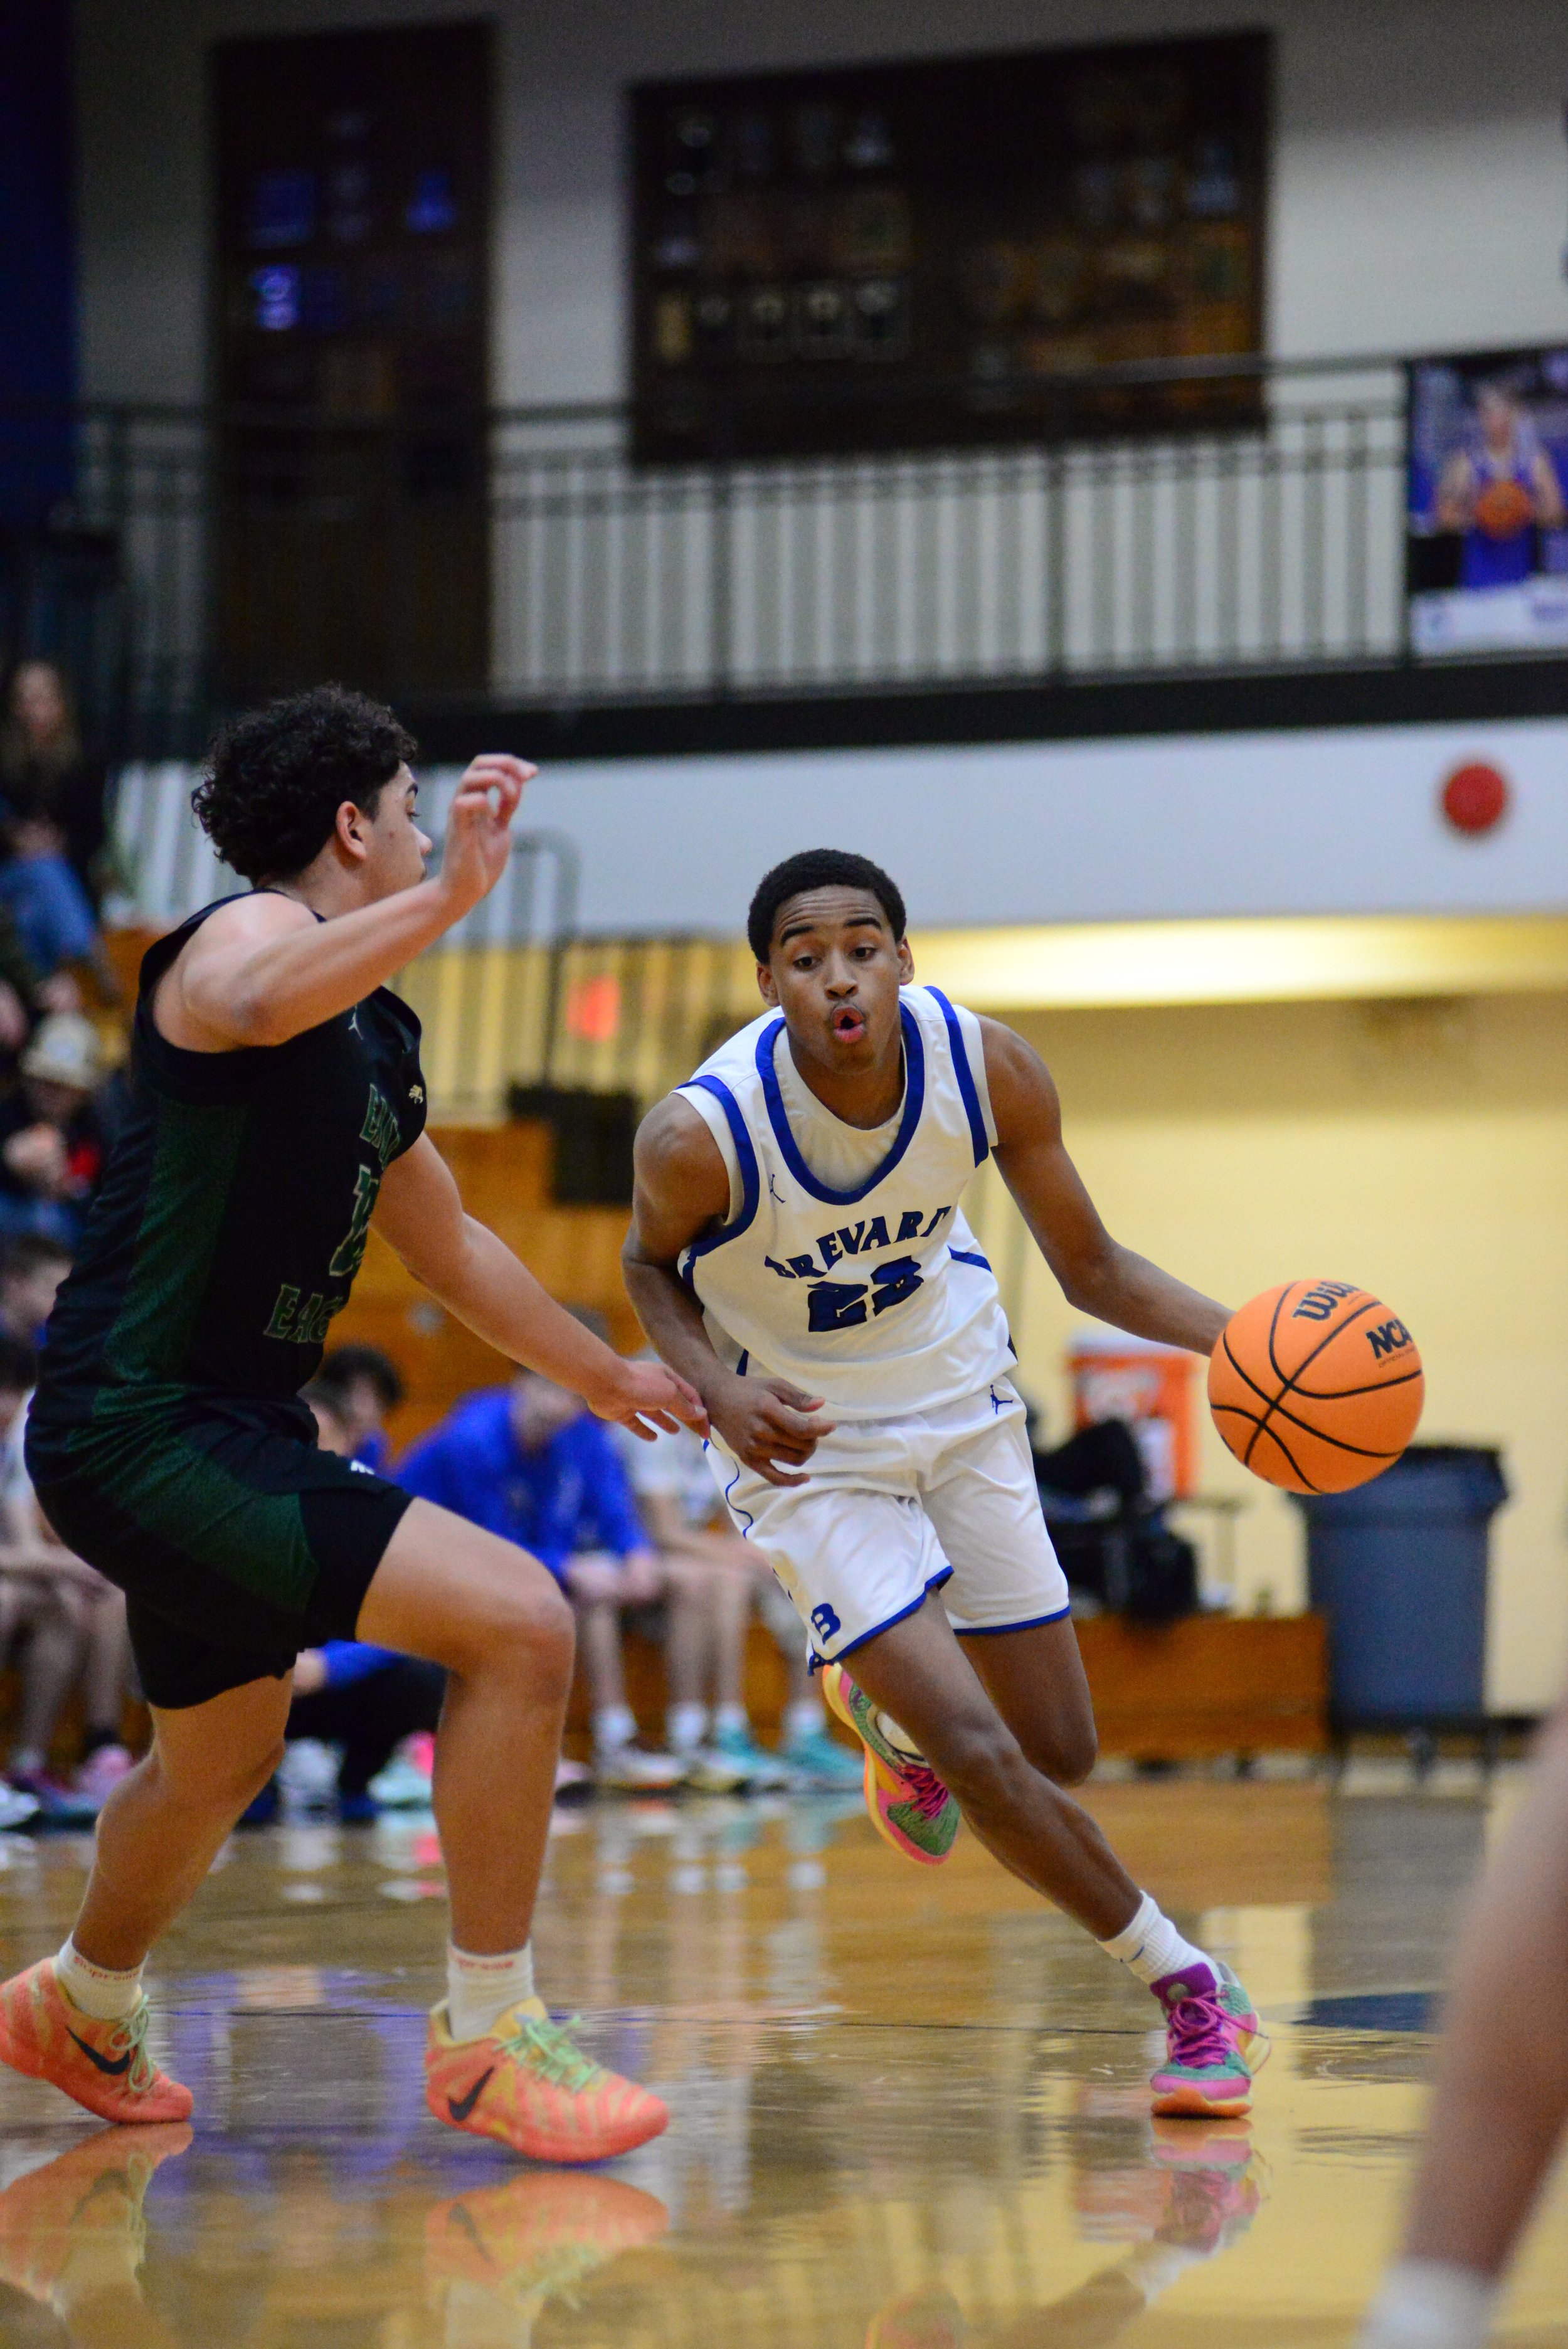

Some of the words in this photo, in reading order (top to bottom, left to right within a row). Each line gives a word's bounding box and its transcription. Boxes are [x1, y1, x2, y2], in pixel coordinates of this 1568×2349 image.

[262, 1283, 344, 1344] EAG
[1365, 1317, 1414, 1360] NCA
[810, 1603, 842, 1645] B
